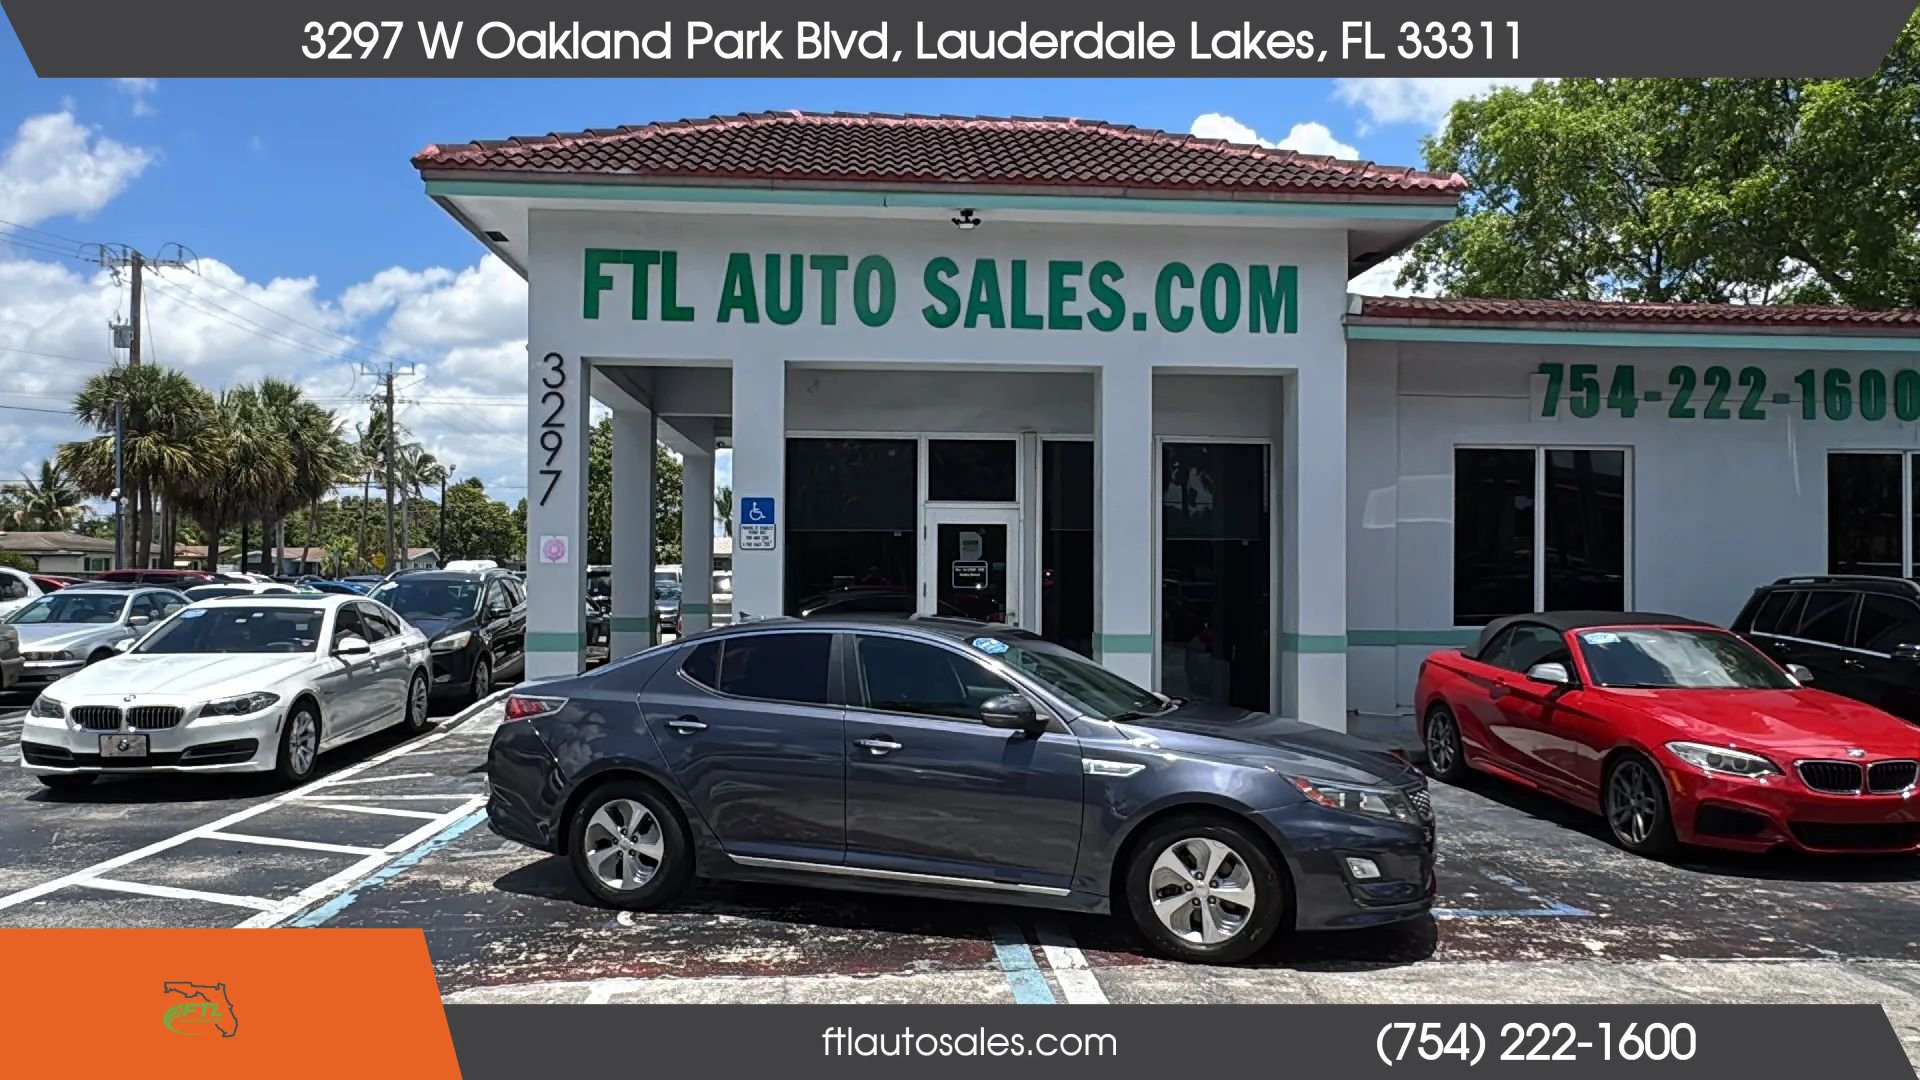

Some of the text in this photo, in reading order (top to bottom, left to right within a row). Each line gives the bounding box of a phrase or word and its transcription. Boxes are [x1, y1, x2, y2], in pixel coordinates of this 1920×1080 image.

[583, 248, 1299, 334] FTL AUTO SALES.COM
[539, 352, 566, 507] 3297
[1539, 363, 1920, 422] 754-222-1600
